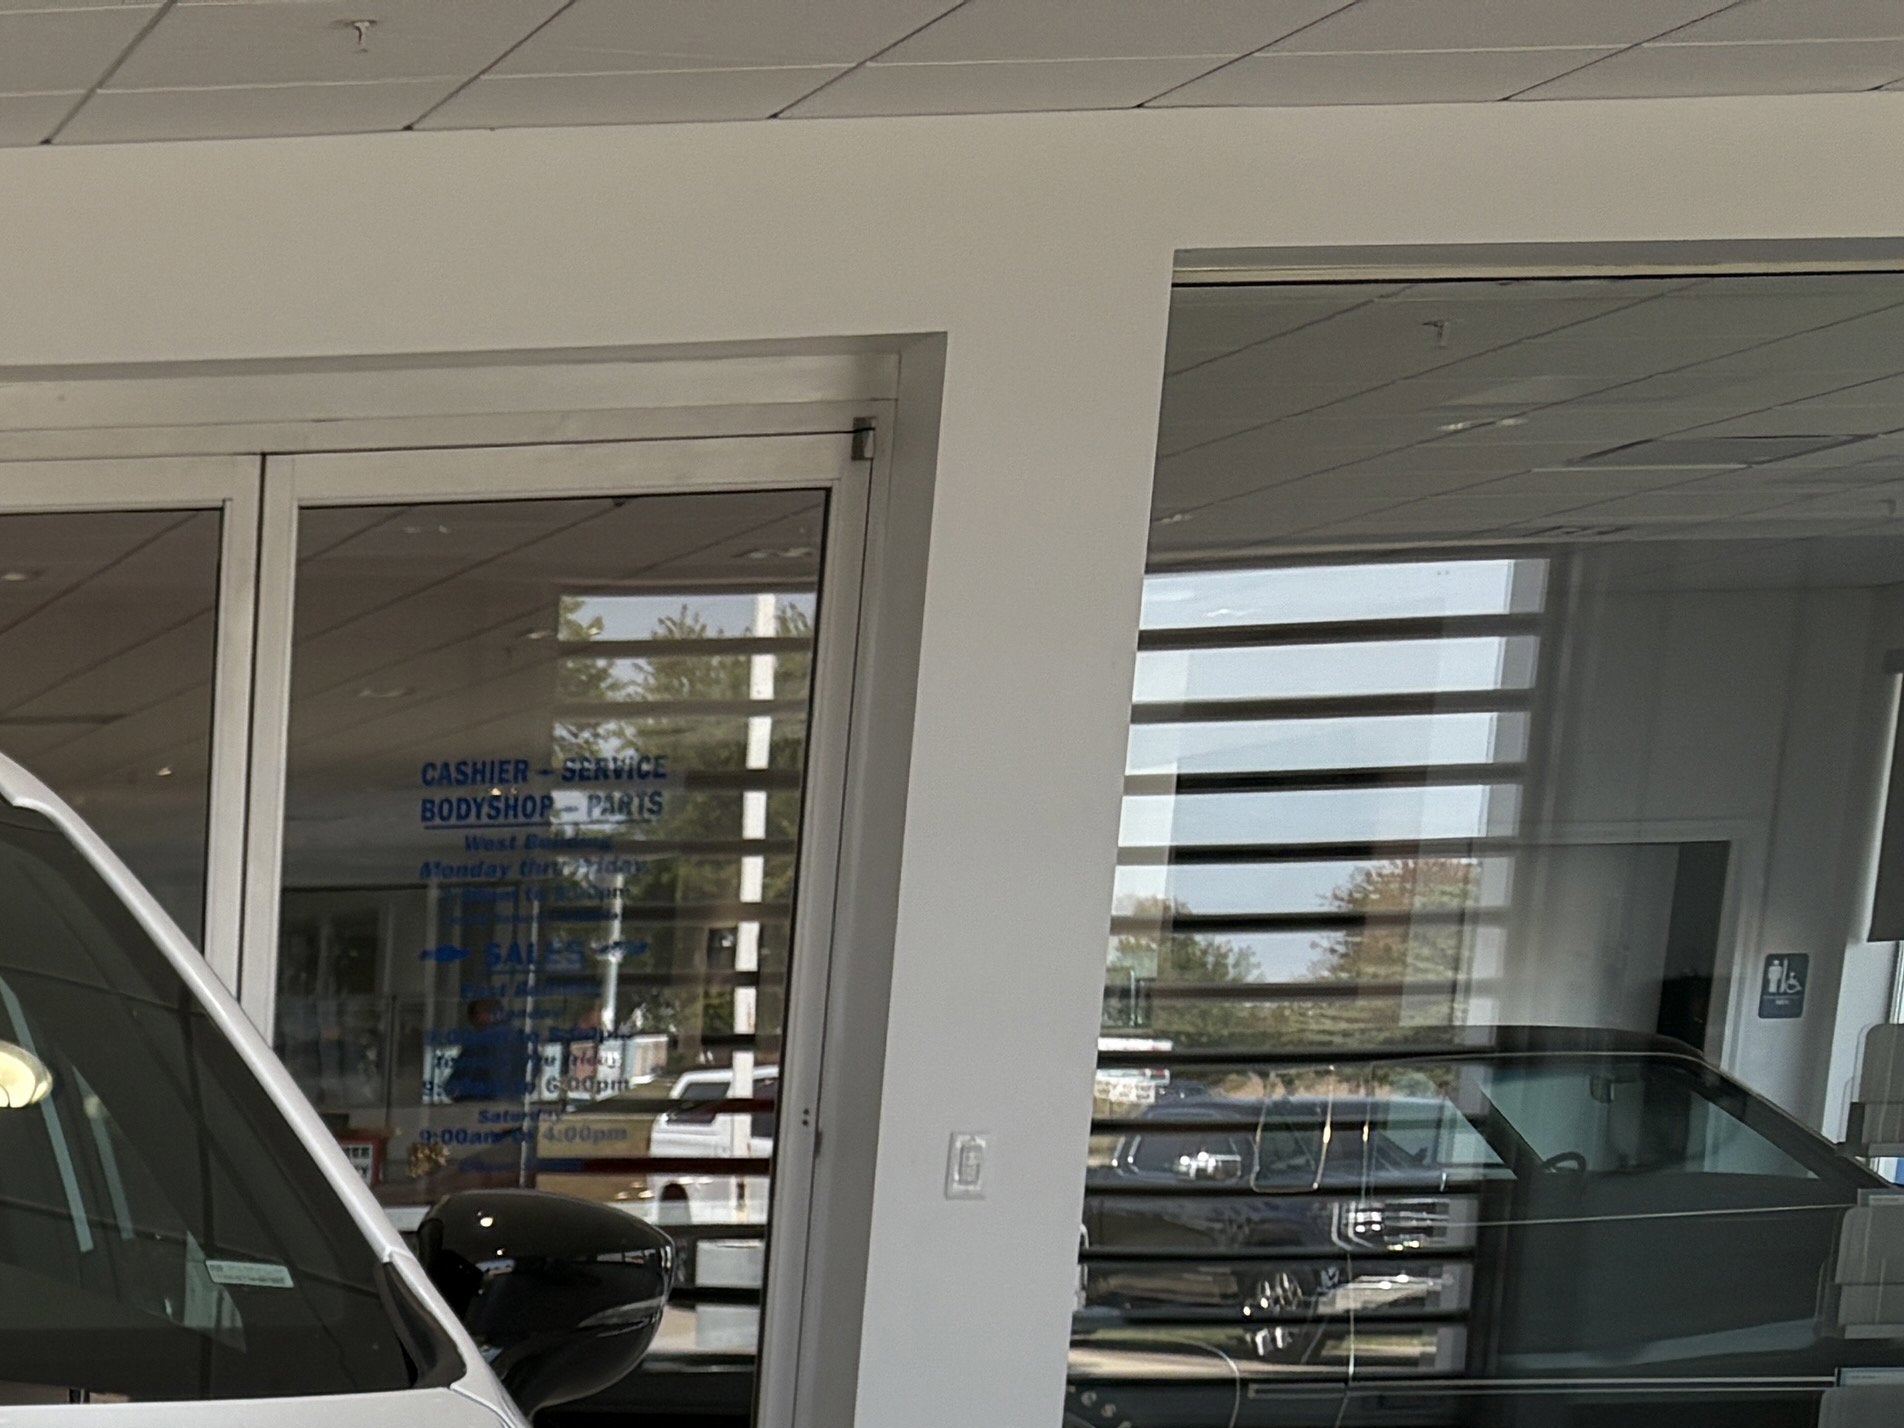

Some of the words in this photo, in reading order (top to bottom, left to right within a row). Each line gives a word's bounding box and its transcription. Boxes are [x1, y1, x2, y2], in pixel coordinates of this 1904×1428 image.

[421, 759, 529, 786] CASHIER
[561, 755, 667, 782] SERVICE
[421, 795, 553, 823] BODYSHOP
[587, 790, 663, 817] PARTS
